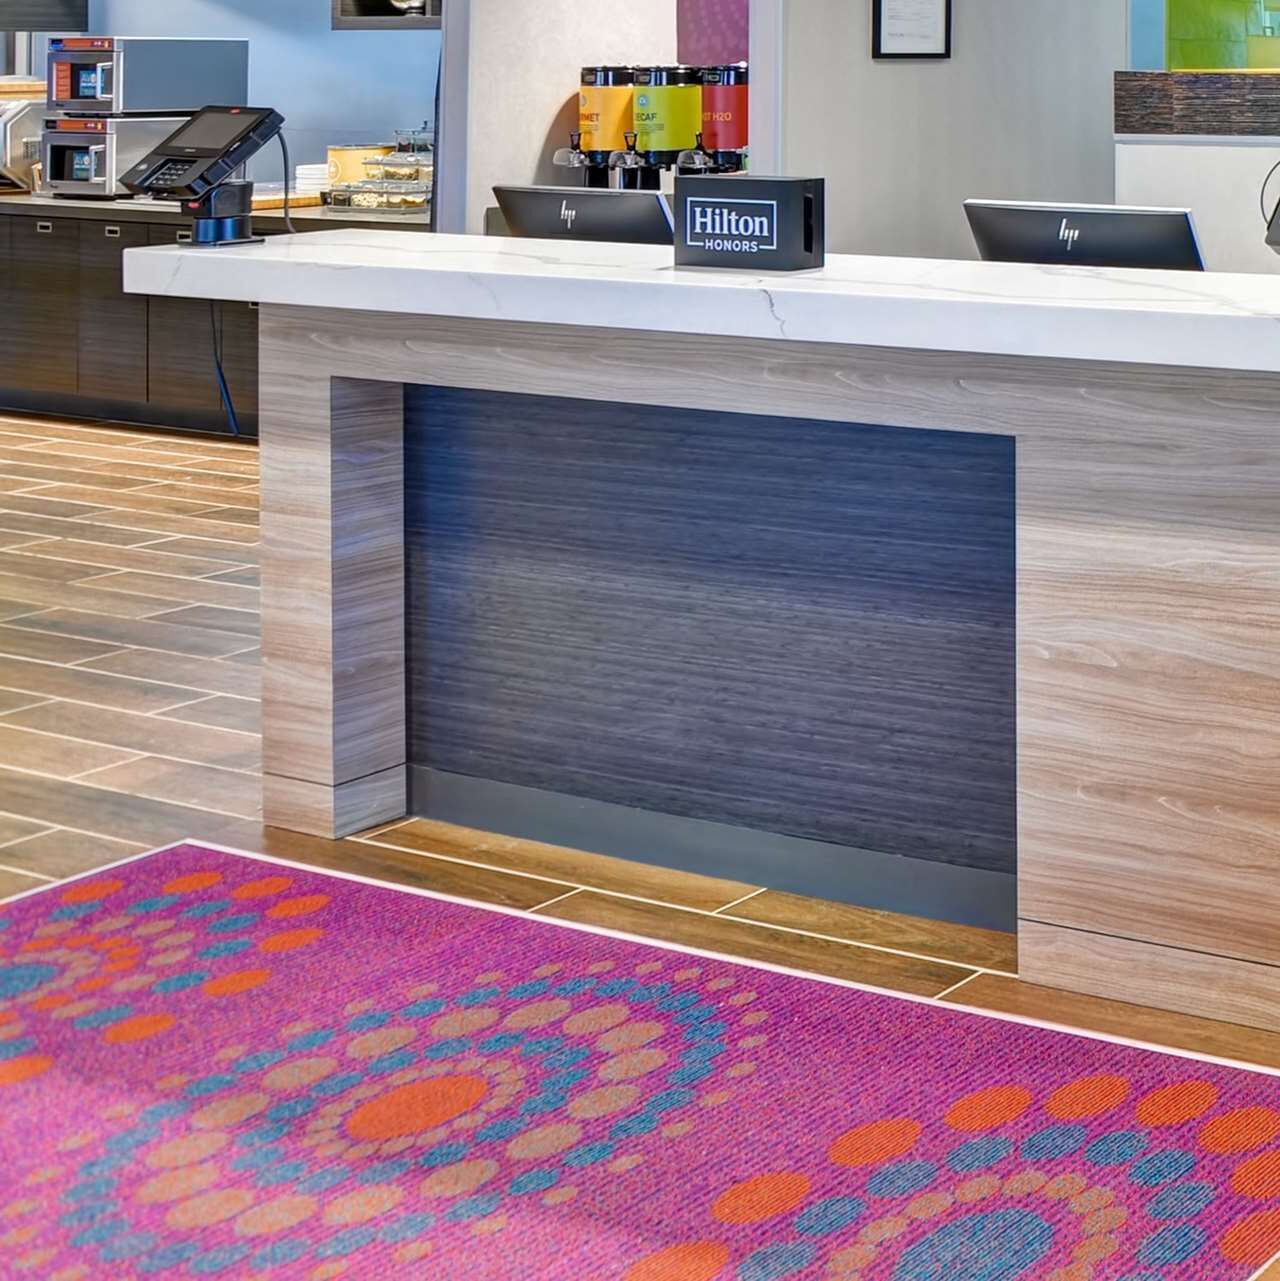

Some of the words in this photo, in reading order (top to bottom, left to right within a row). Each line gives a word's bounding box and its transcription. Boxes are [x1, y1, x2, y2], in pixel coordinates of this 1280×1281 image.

[712, 111, 732, 121] H2O
[694, 207, 769, 236] Hilton
[705, 239, 758, 252] HONORS
